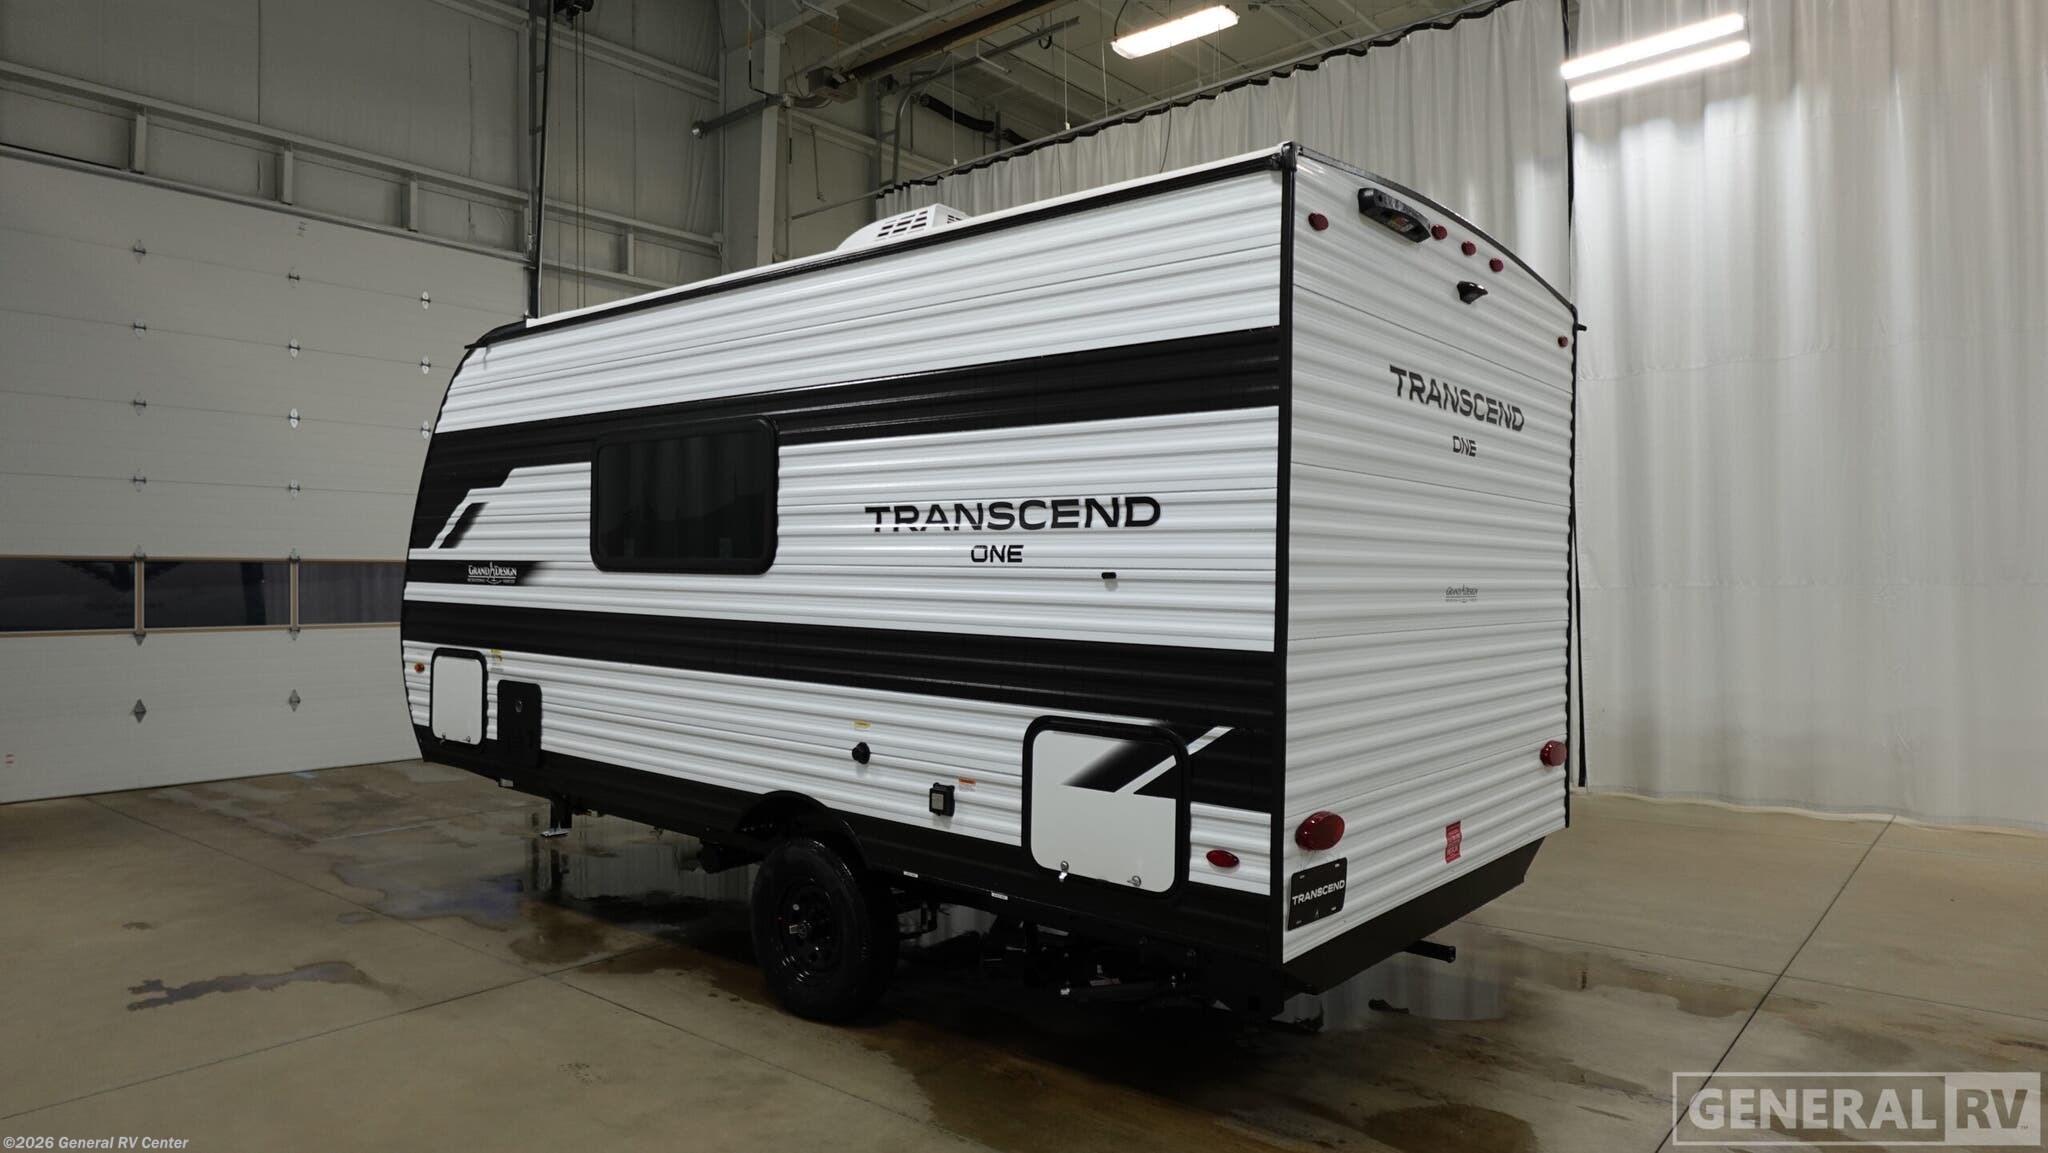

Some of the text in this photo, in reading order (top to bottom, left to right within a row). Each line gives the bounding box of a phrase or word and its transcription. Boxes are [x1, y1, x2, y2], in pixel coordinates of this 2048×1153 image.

[1389, 364, 1525, 432] TRANSCEND
[1452, 435, 1477, 458] ONE
[864, 496, 1162, 533] TRANSCEND
[970, 544, 1024, 563] ONE
[467, 564, 518, 577] GRAND DESIGN
[1291, 879, 1346, 906] TRANSCEND
